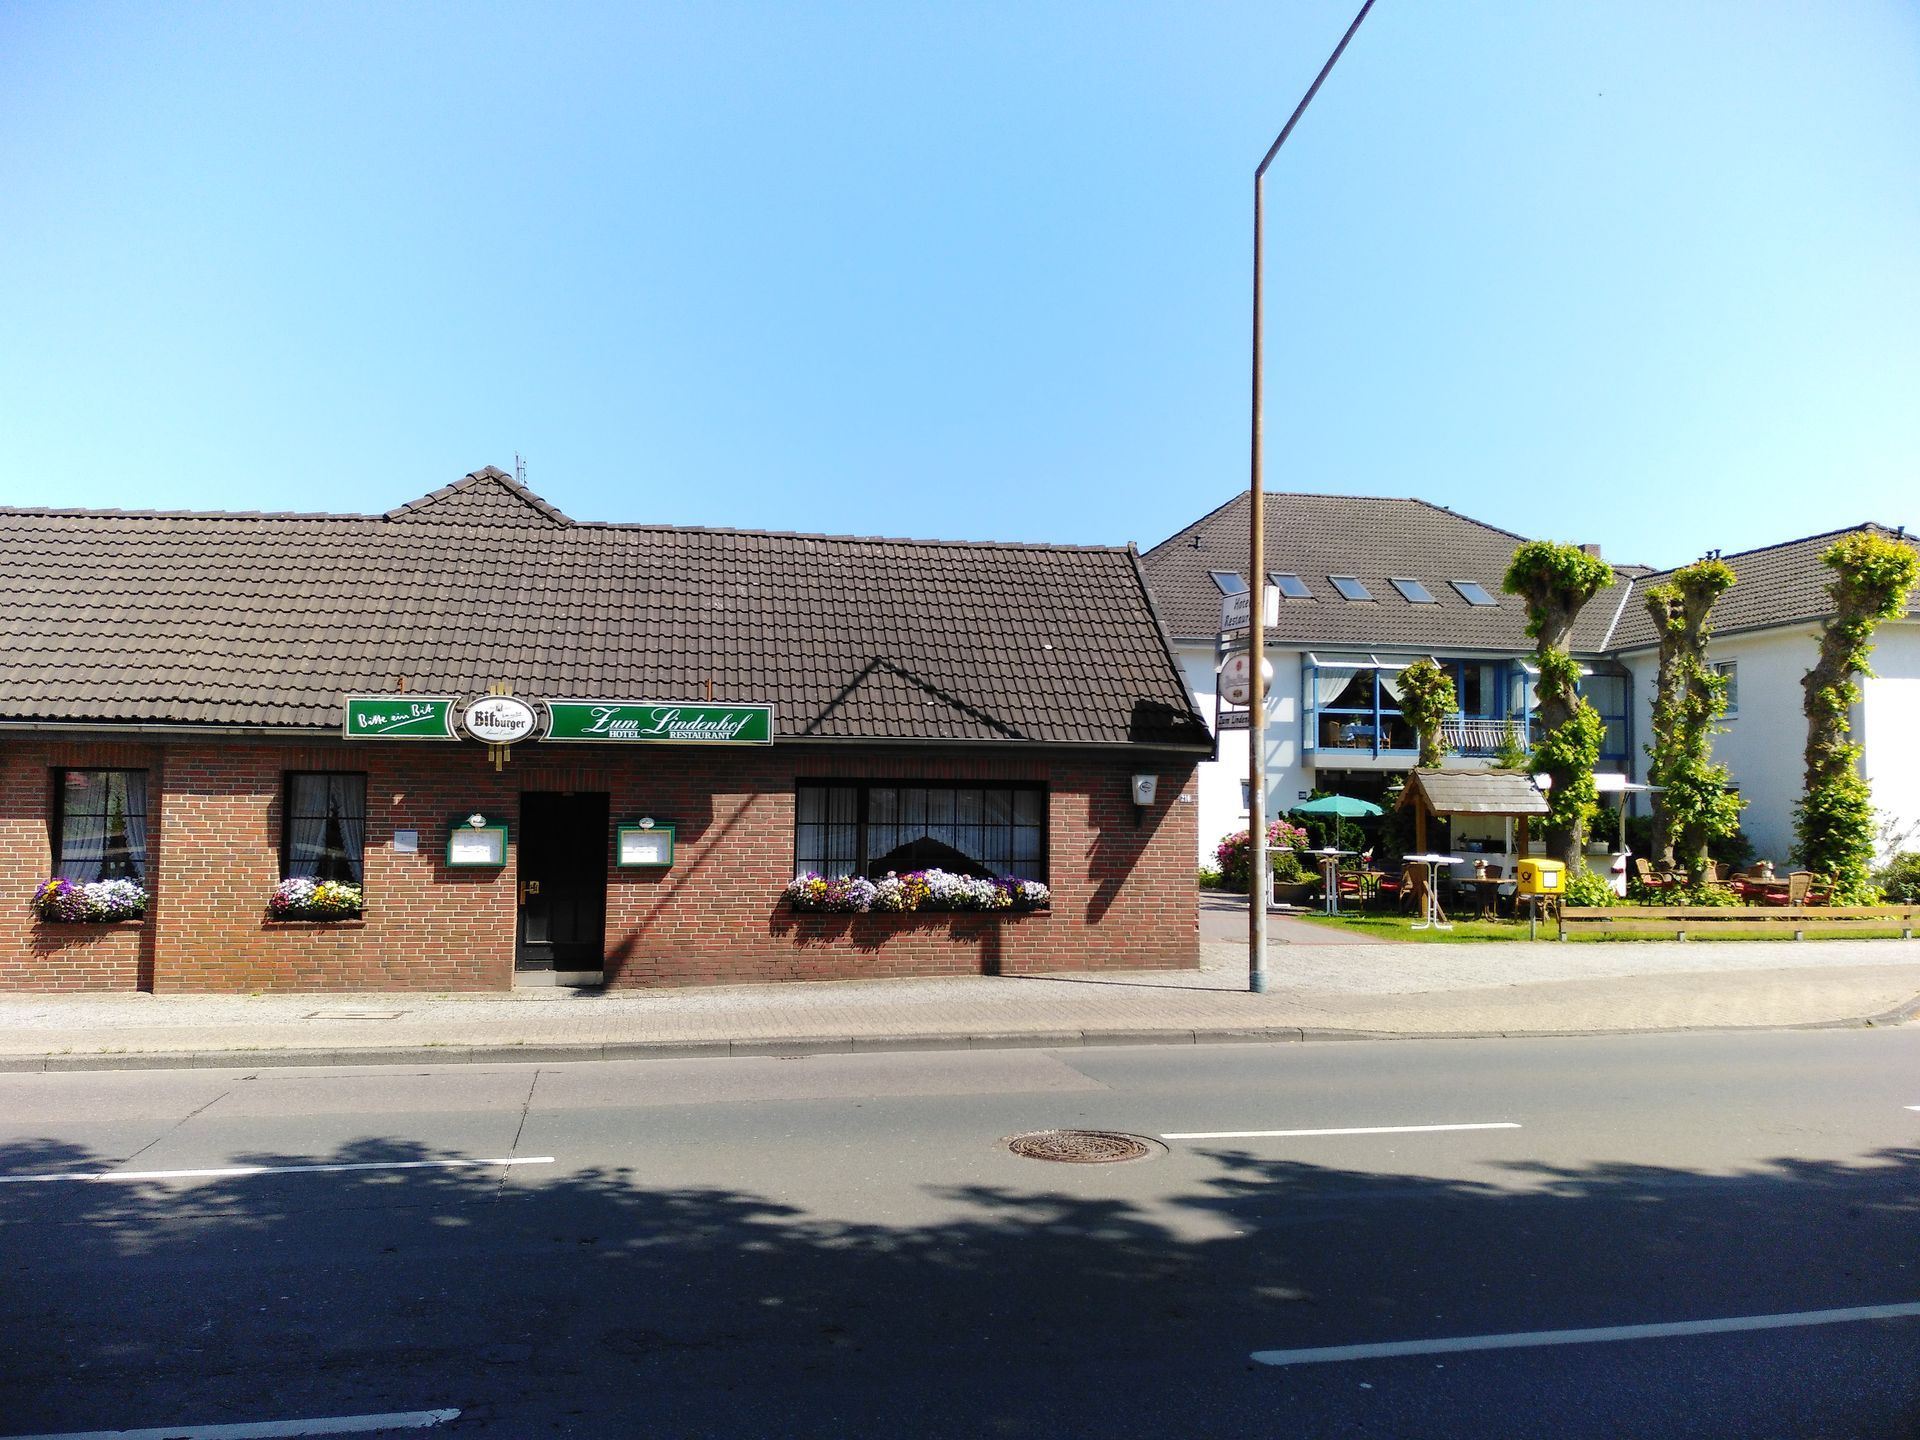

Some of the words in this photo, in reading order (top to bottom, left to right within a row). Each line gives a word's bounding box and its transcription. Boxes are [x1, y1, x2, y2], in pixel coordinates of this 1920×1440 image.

[1233, 597, 1250, 610] Hote
[1224, 614, 1250, 627] Restaur
[357, 713, 388, 728] Bitte
[390, 713, 410, 721] ein
[411, 703, 435, 717] Bit
[473, 710, 526, 731] Bitburger
[580, 706, 640, 733] Zum
[640, 707, 754, 737] Lindenhof
[1231, 713, 1250, 724] Linden
[608, 730, 641, 738] HOTEL
[669, 731, 732, 740] RESTAURANT
